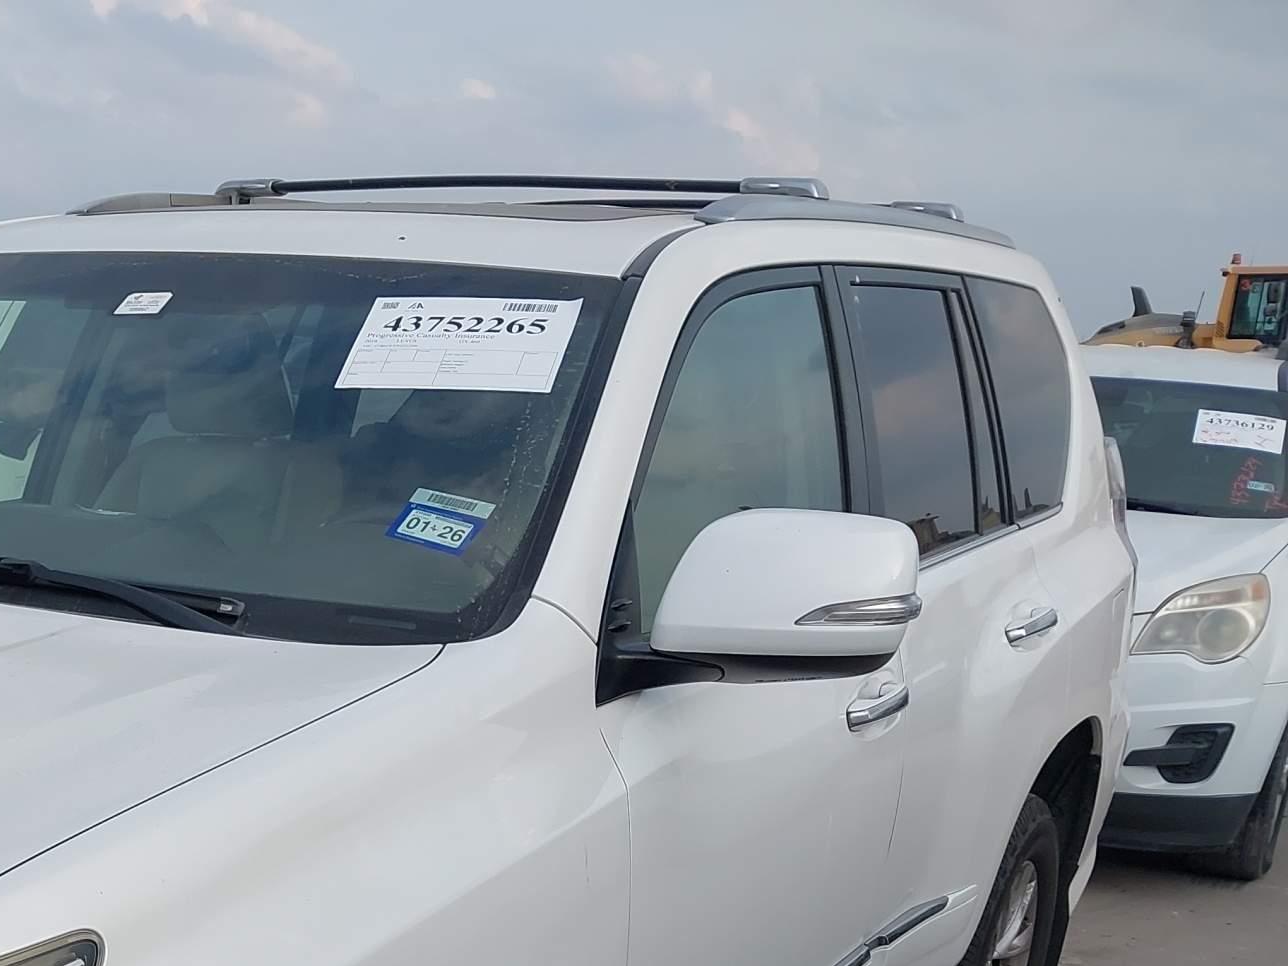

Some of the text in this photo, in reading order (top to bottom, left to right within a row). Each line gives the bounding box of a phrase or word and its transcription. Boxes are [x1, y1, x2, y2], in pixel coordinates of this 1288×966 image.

[383, 315, 550, 334] 43752265
[366, 332, 415, 340] Progressive
[416, 332, 452, 340] Casualty
[1205, 418, 1275, 431] 43736129
[406, 517, 466, 543] 01 26
